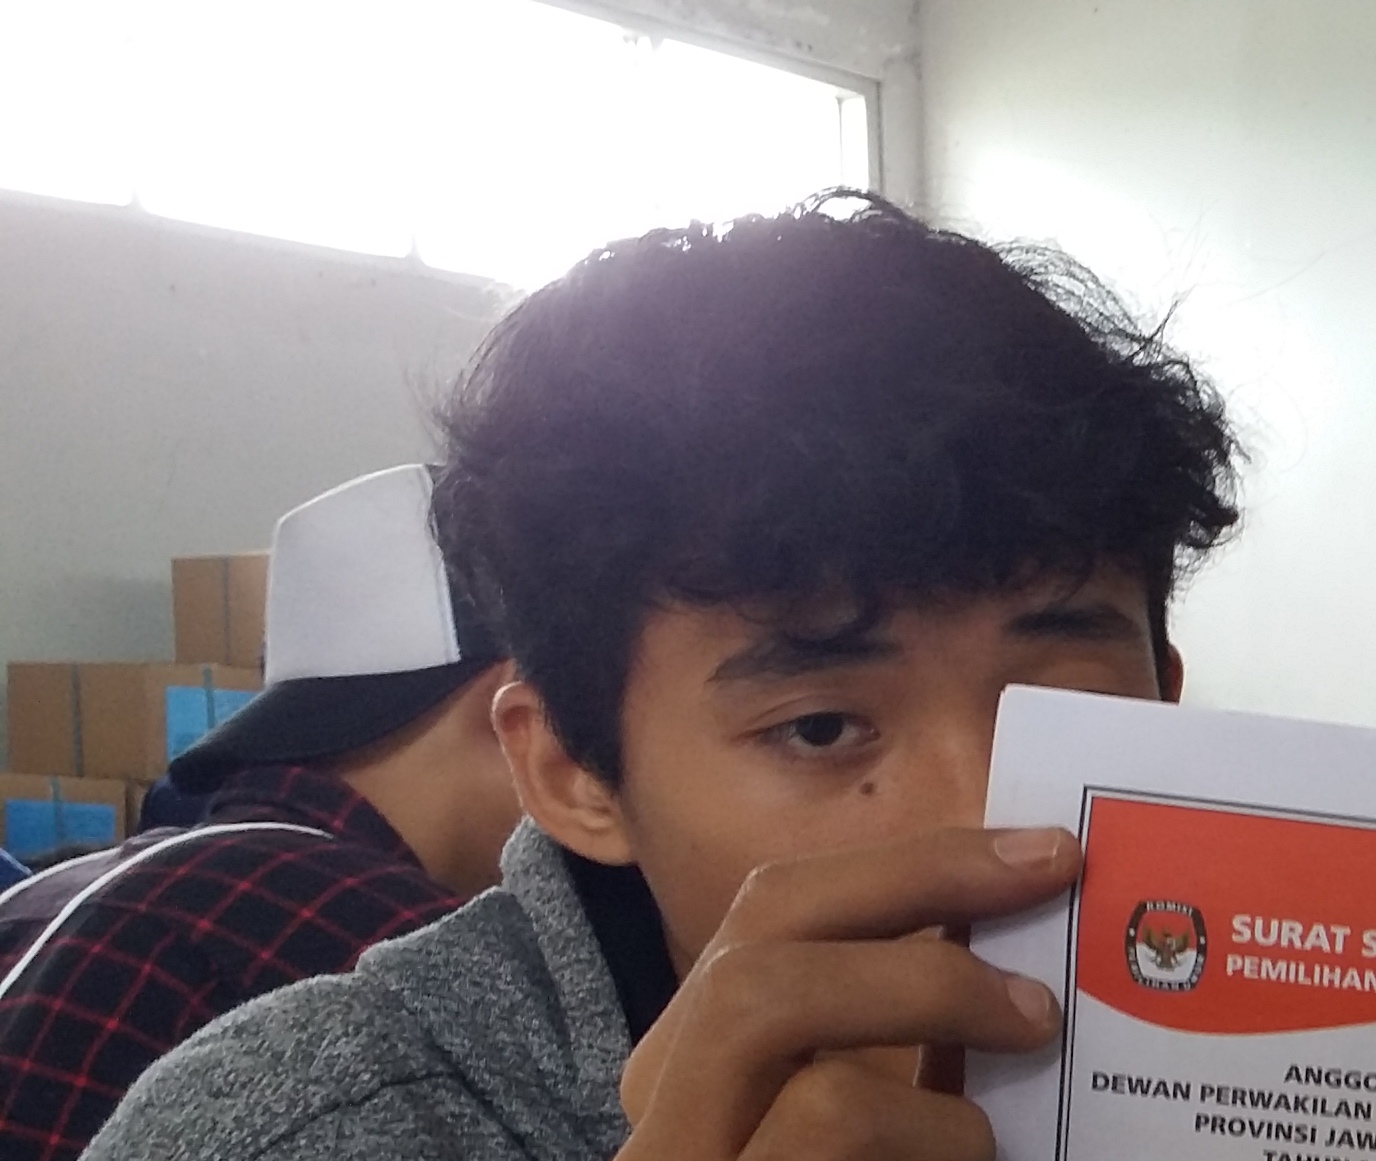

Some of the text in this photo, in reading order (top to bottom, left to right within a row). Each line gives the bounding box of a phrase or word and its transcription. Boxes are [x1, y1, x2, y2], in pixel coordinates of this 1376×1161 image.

[1231, 913, 1351, 955] SURAT
[1090, 1070, 1192, 1101] DEWAN
[1199, 1083, 1373, 1121] PERWAKILAN
[1194, 1112, 1317, 1146] PROVINSI
